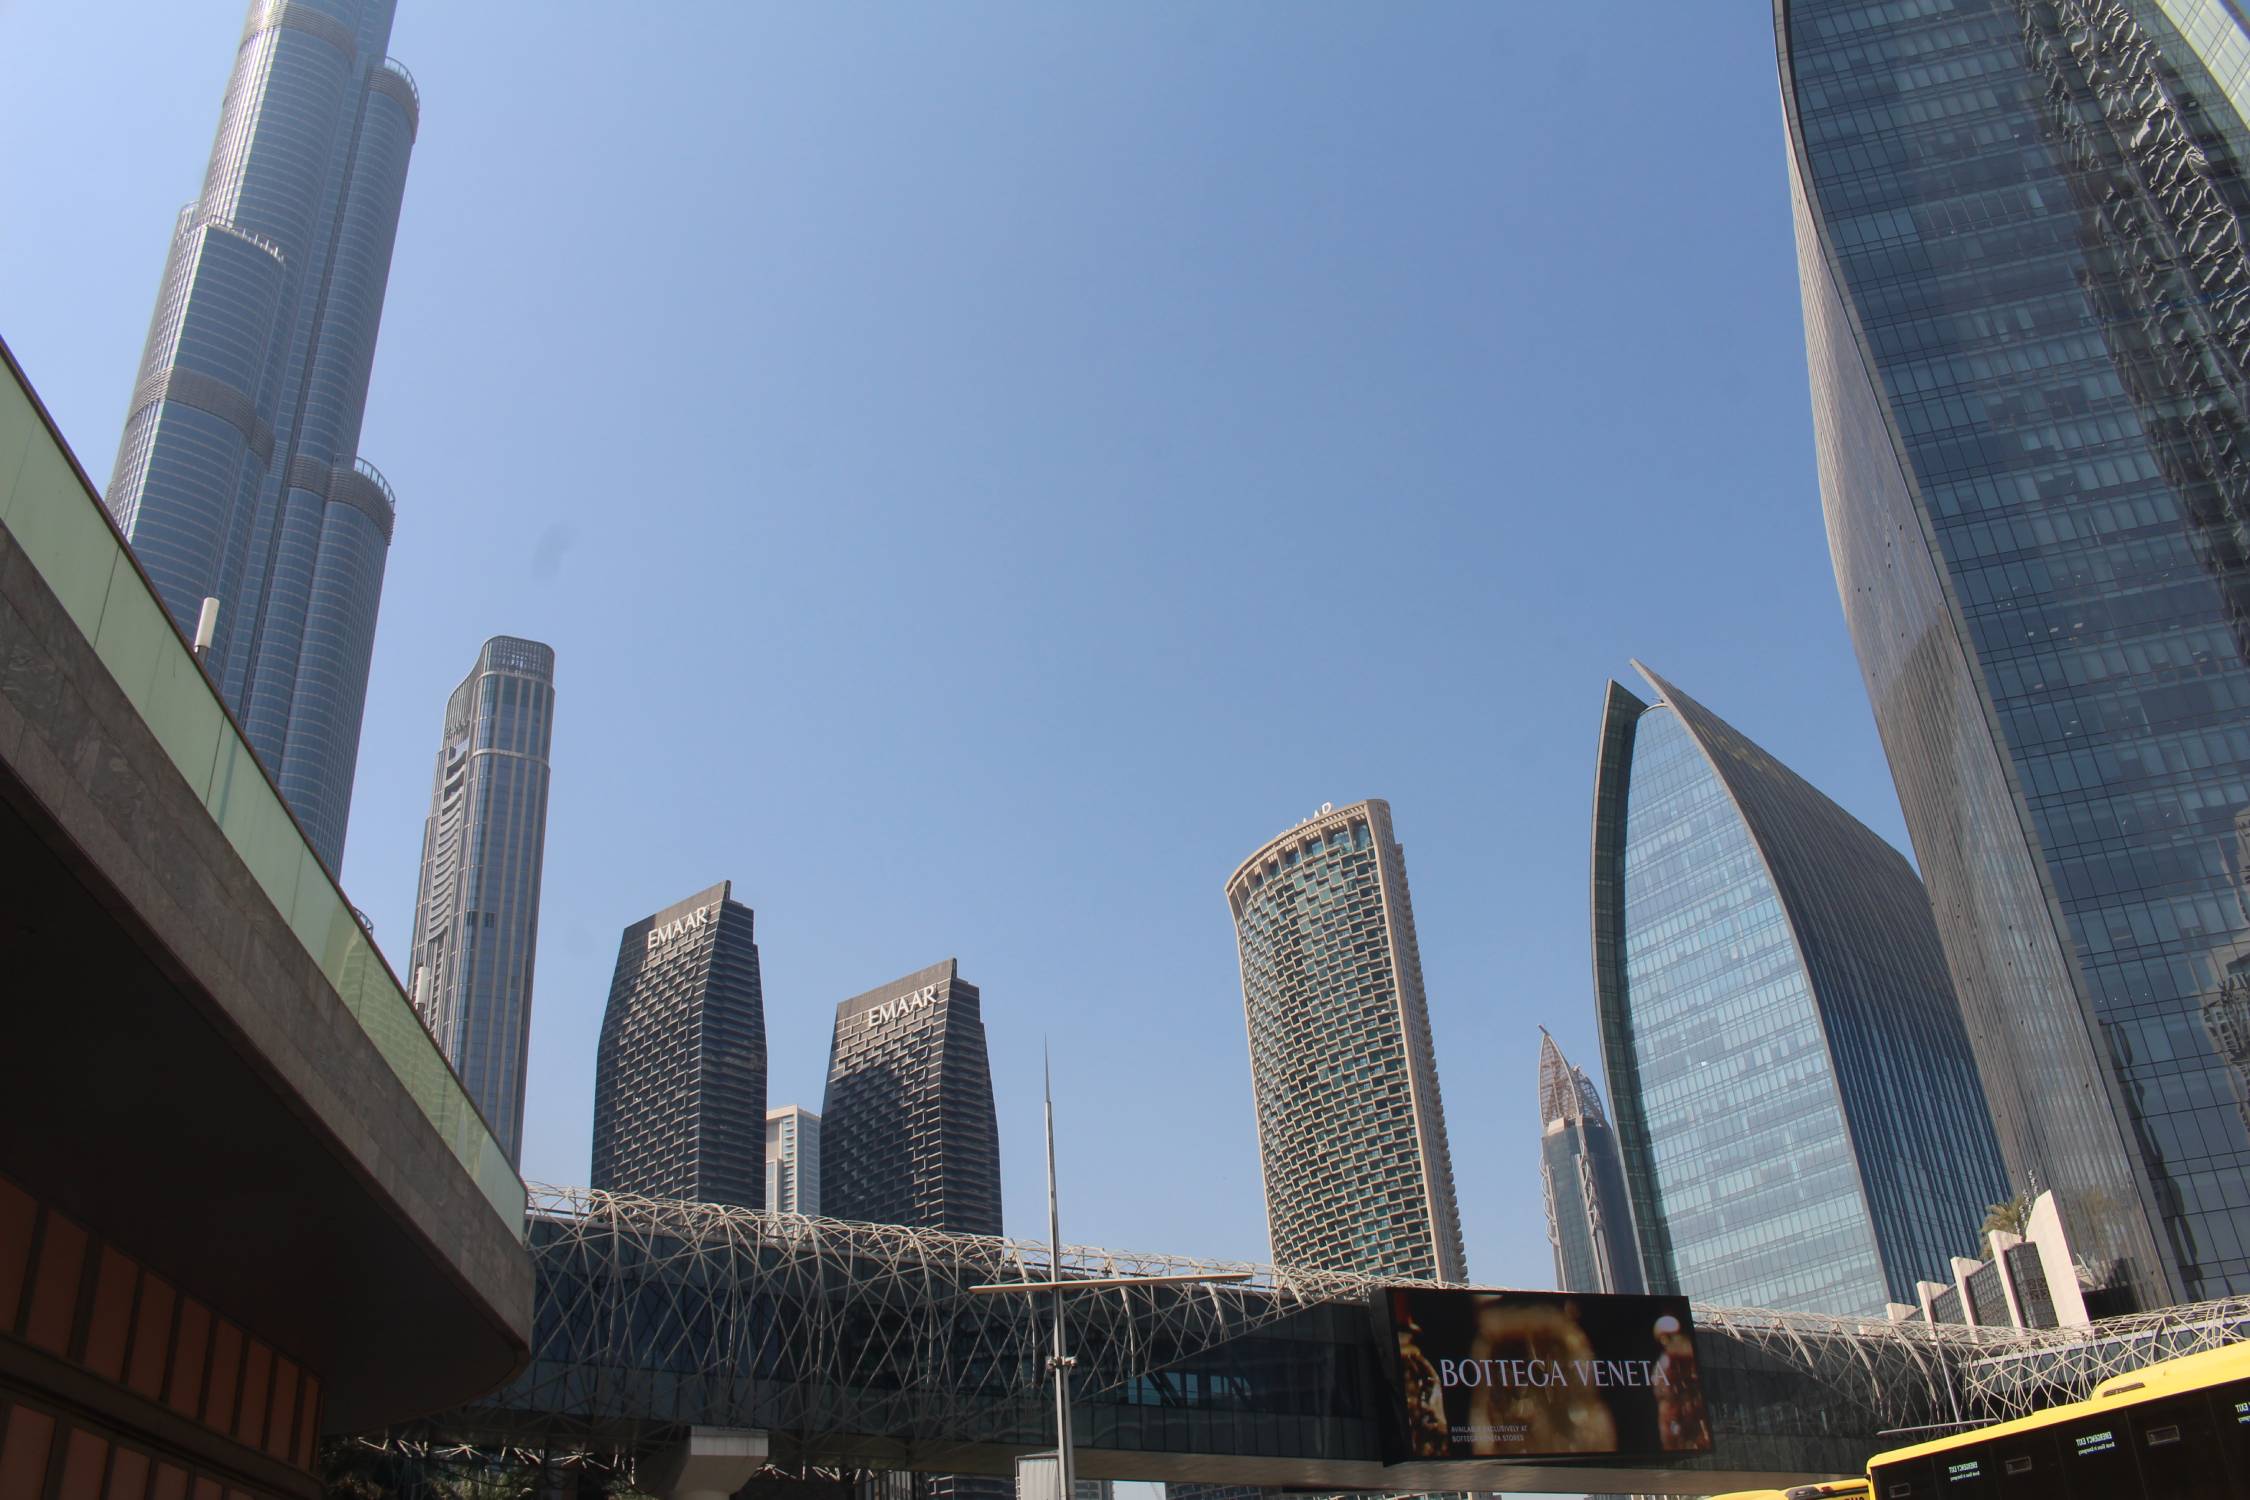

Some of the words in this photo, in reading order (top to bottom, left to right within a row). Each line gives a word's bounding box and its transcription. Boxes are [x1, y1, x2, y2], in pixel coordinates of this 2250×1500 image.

[648, 907, 707, 949] EMAAR
[869, 985, 936, 1027] EMAAR
[1440, 1359, 1568, 1387] BOTTEGA
[1574, 1360, 1670, 1387] VENETA
[1451, 1425, 1481, 1433] AVAILA
[1484, 1425, 1519, 1433] CLUSIVELY
